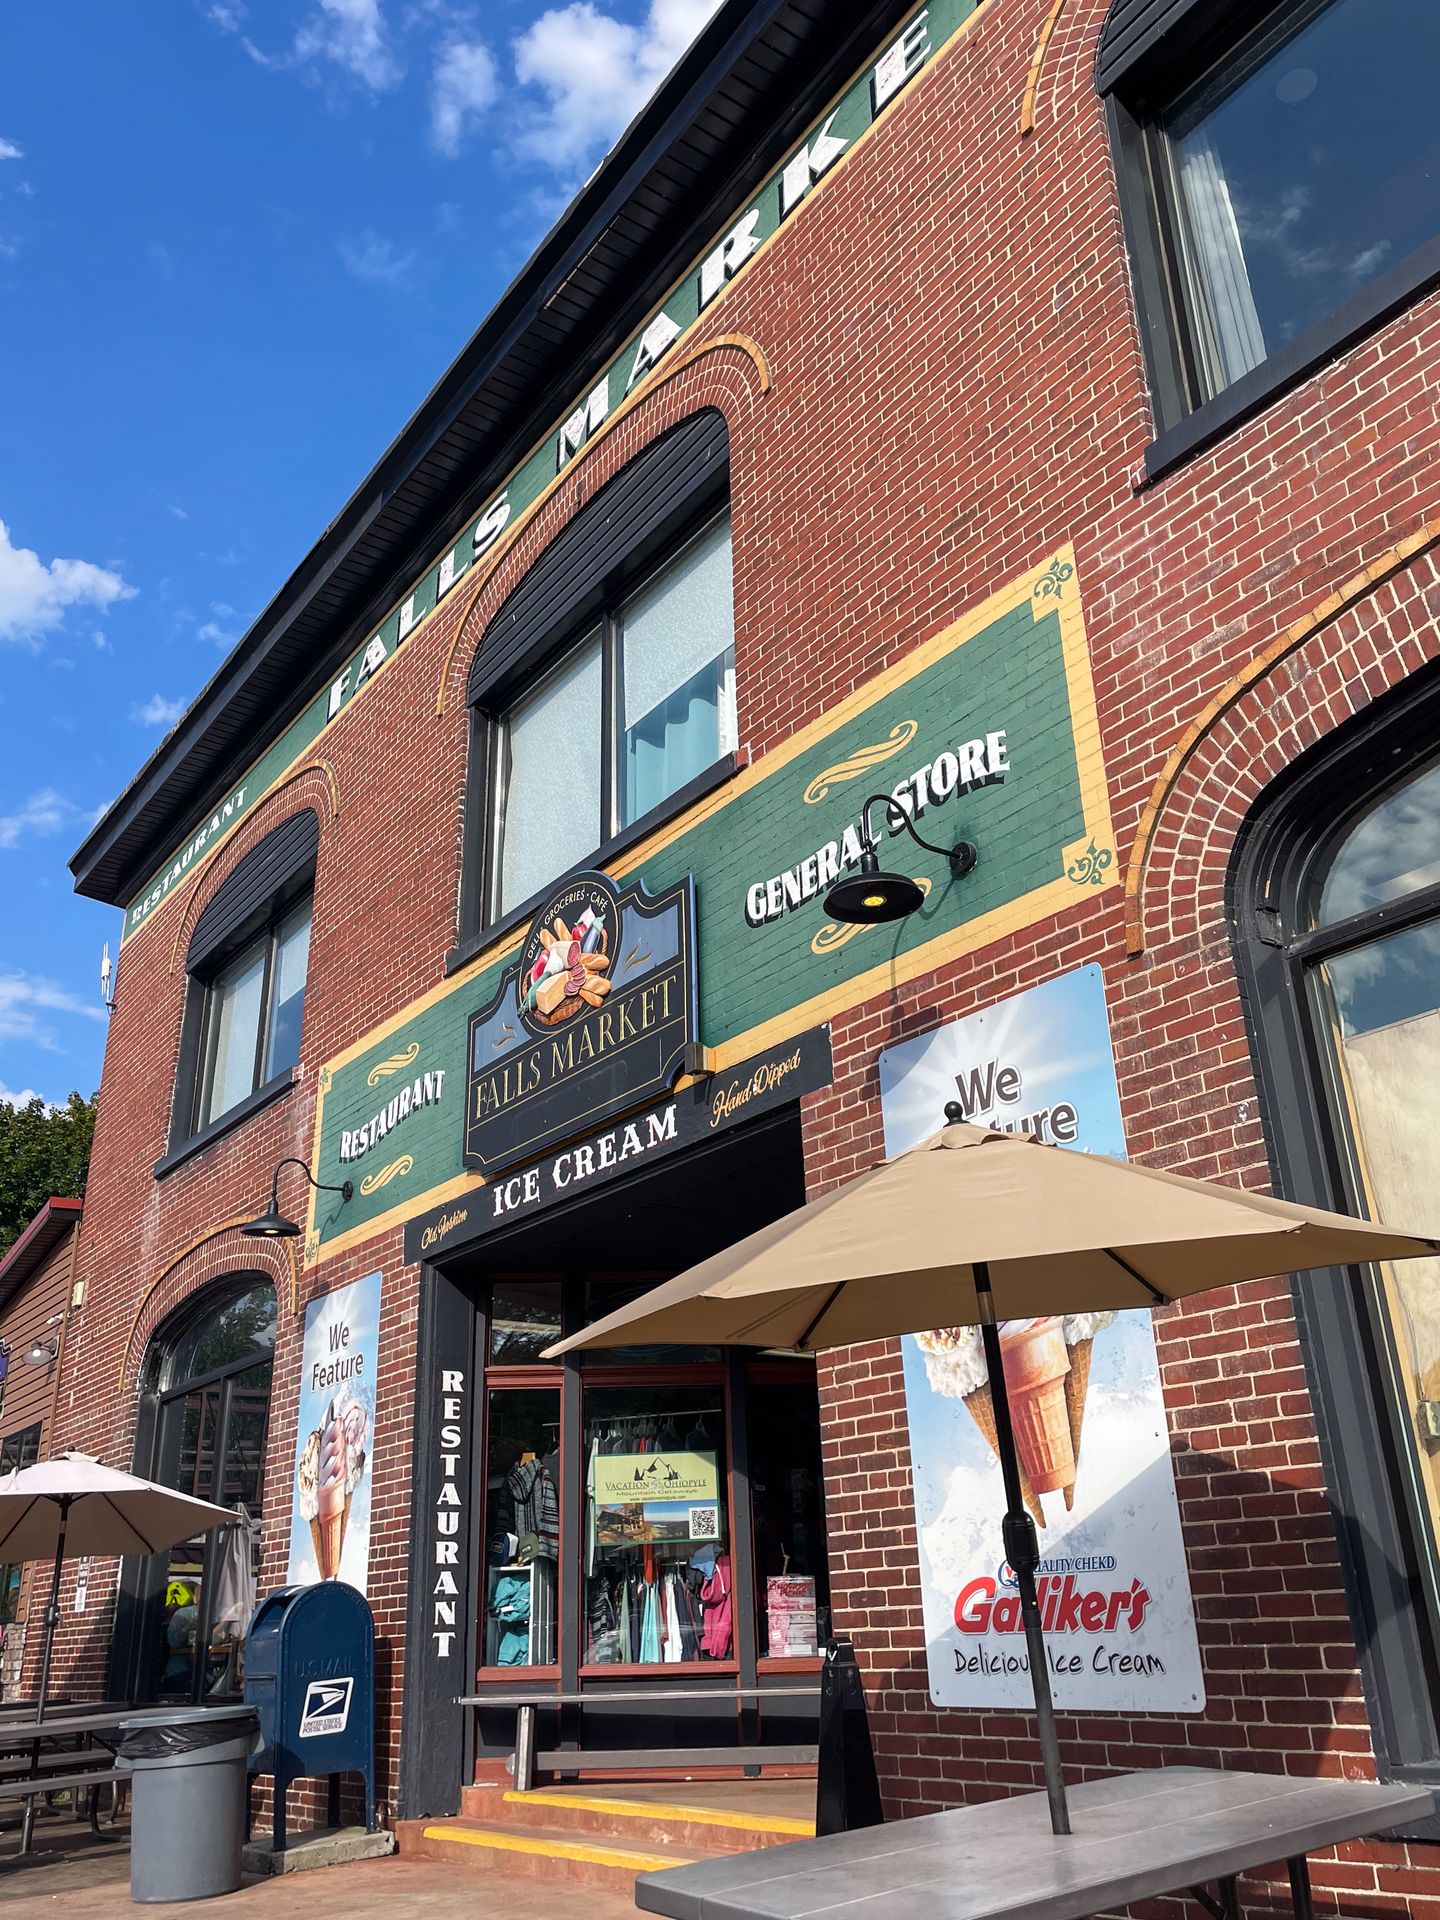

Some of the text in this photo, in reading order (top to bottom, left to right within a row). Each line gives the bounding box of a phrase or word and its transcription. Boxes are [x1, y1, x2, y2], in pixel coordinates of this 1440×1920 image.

[131, 8, 934, 925] RESTAURANT FALLS MARKE
[746, 729, 1011, 923] GENERAL STORE
[527, 933, 541, 959] DELI
[544, 888, 586, 926] GROCERIES
[474, 974, 677, 1121] FALLS MARKET
[339, 1069, 446, 1160] RESTAURANT
[709, 1047, 801, 1128] Hand Dipped
[952, 1057, 1022, 1119] We
[492, 1103, 678, 1217] ICE CREAM
[311, 1351, 365, 1394] Feature
[328, 1321, 350, 1354] We
[432, 1369, 465, 1658] RESTAURANT
[605, 1478, 707, 1490] VACATION OHIOPYLE
[954, 1574, 1151, 1634] Galiker's
[954, 1643, 1167, 1676] Deliciou Ice Cream
